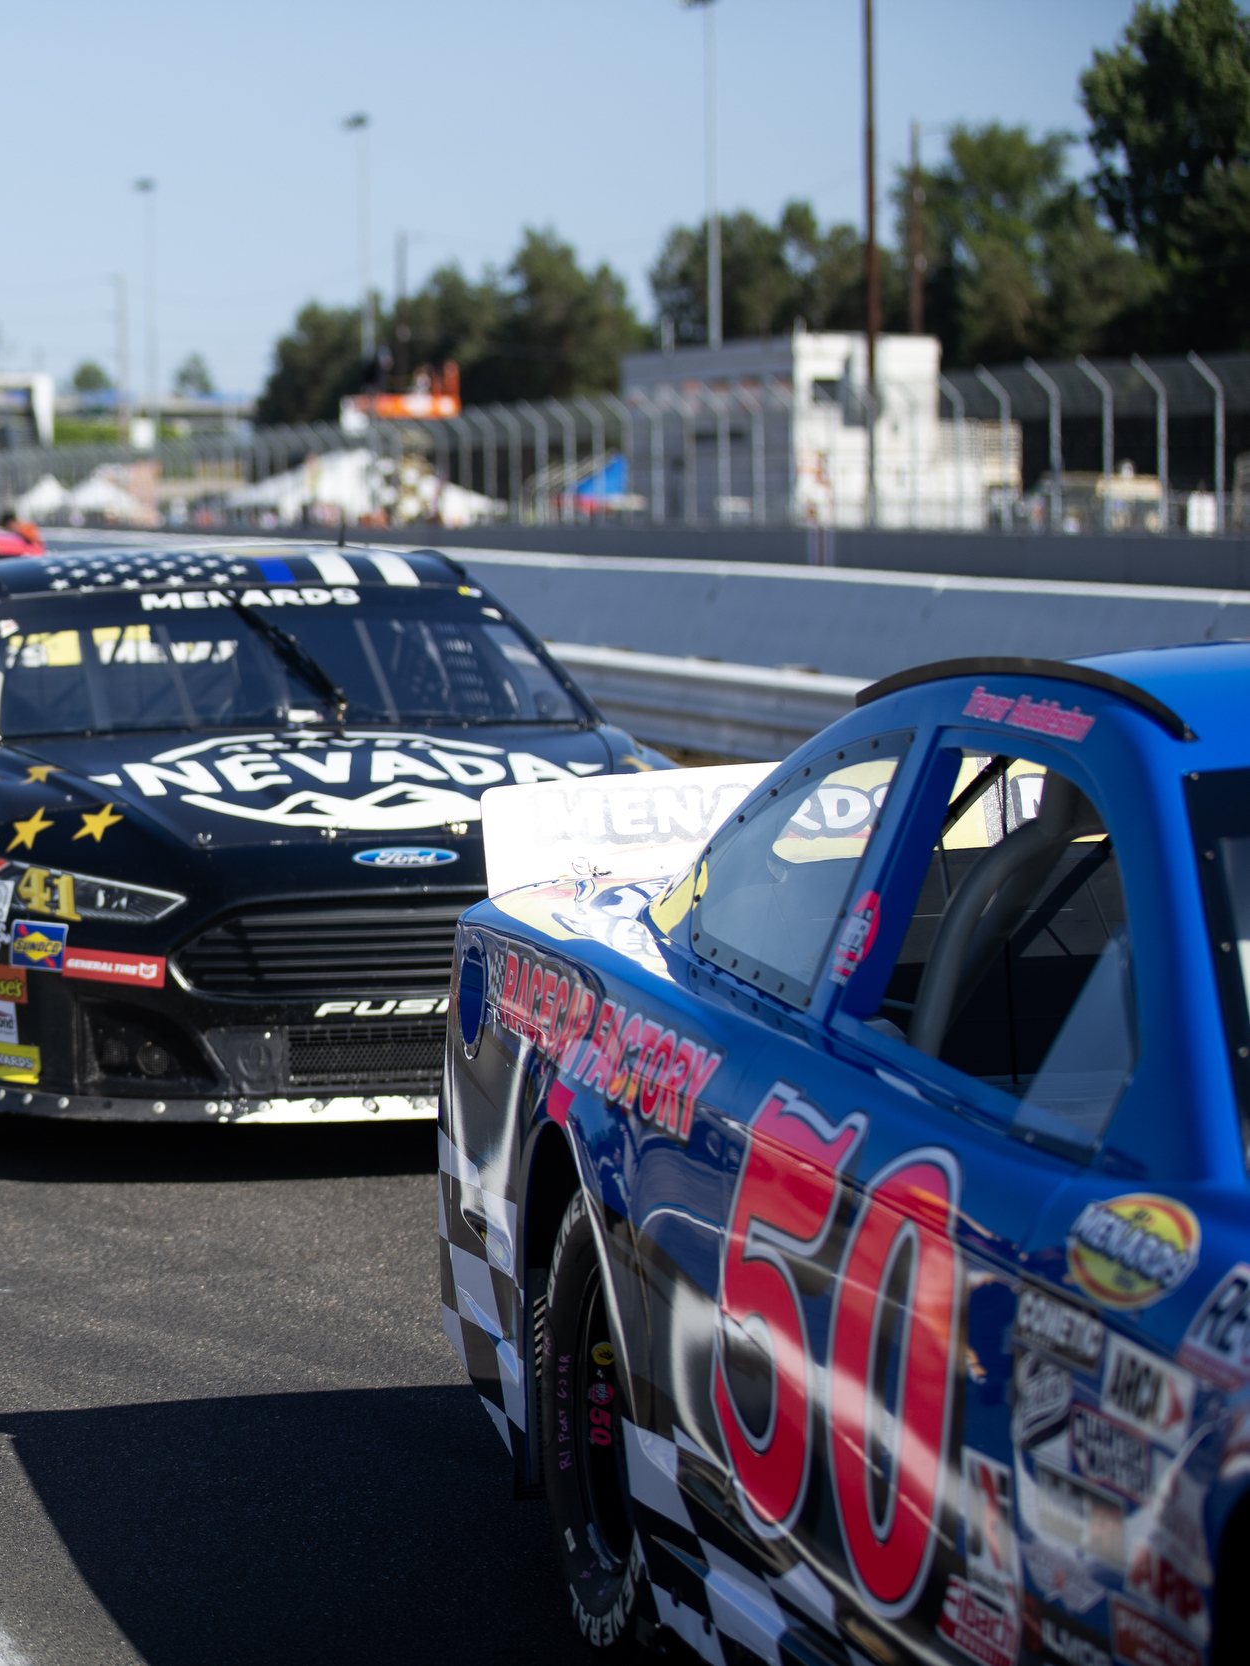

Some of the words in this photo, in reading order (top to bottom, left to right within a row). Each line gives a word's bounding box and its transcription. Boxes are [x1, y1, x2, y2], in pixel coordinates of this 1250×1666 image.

[140, 587, 361, 611] MENARDS
[122, 749, 580, 797] NEVADA
[533, 781, 890, 844] MENARD
[374, 850, 438, 866] Ford
[17, 865, 82, 922] 41
[14, 939, 63, 955] SUNOCO
[65, 958, 114, 973] GENERAL
[114, 963, 139, 976] TIRE
[314, 998, 450, 1018] FUSI
[500, 949, 597, 1075] RACECAR
[572, 997, 725, 1141] FACTORY
[1067, 1201, 1190, 1290] MENARDS
[711, 1078, 962, 1620] 50
[1108, 1350, 1164, 1423] ARCA
[589, 1405, 612, 1446] 50
